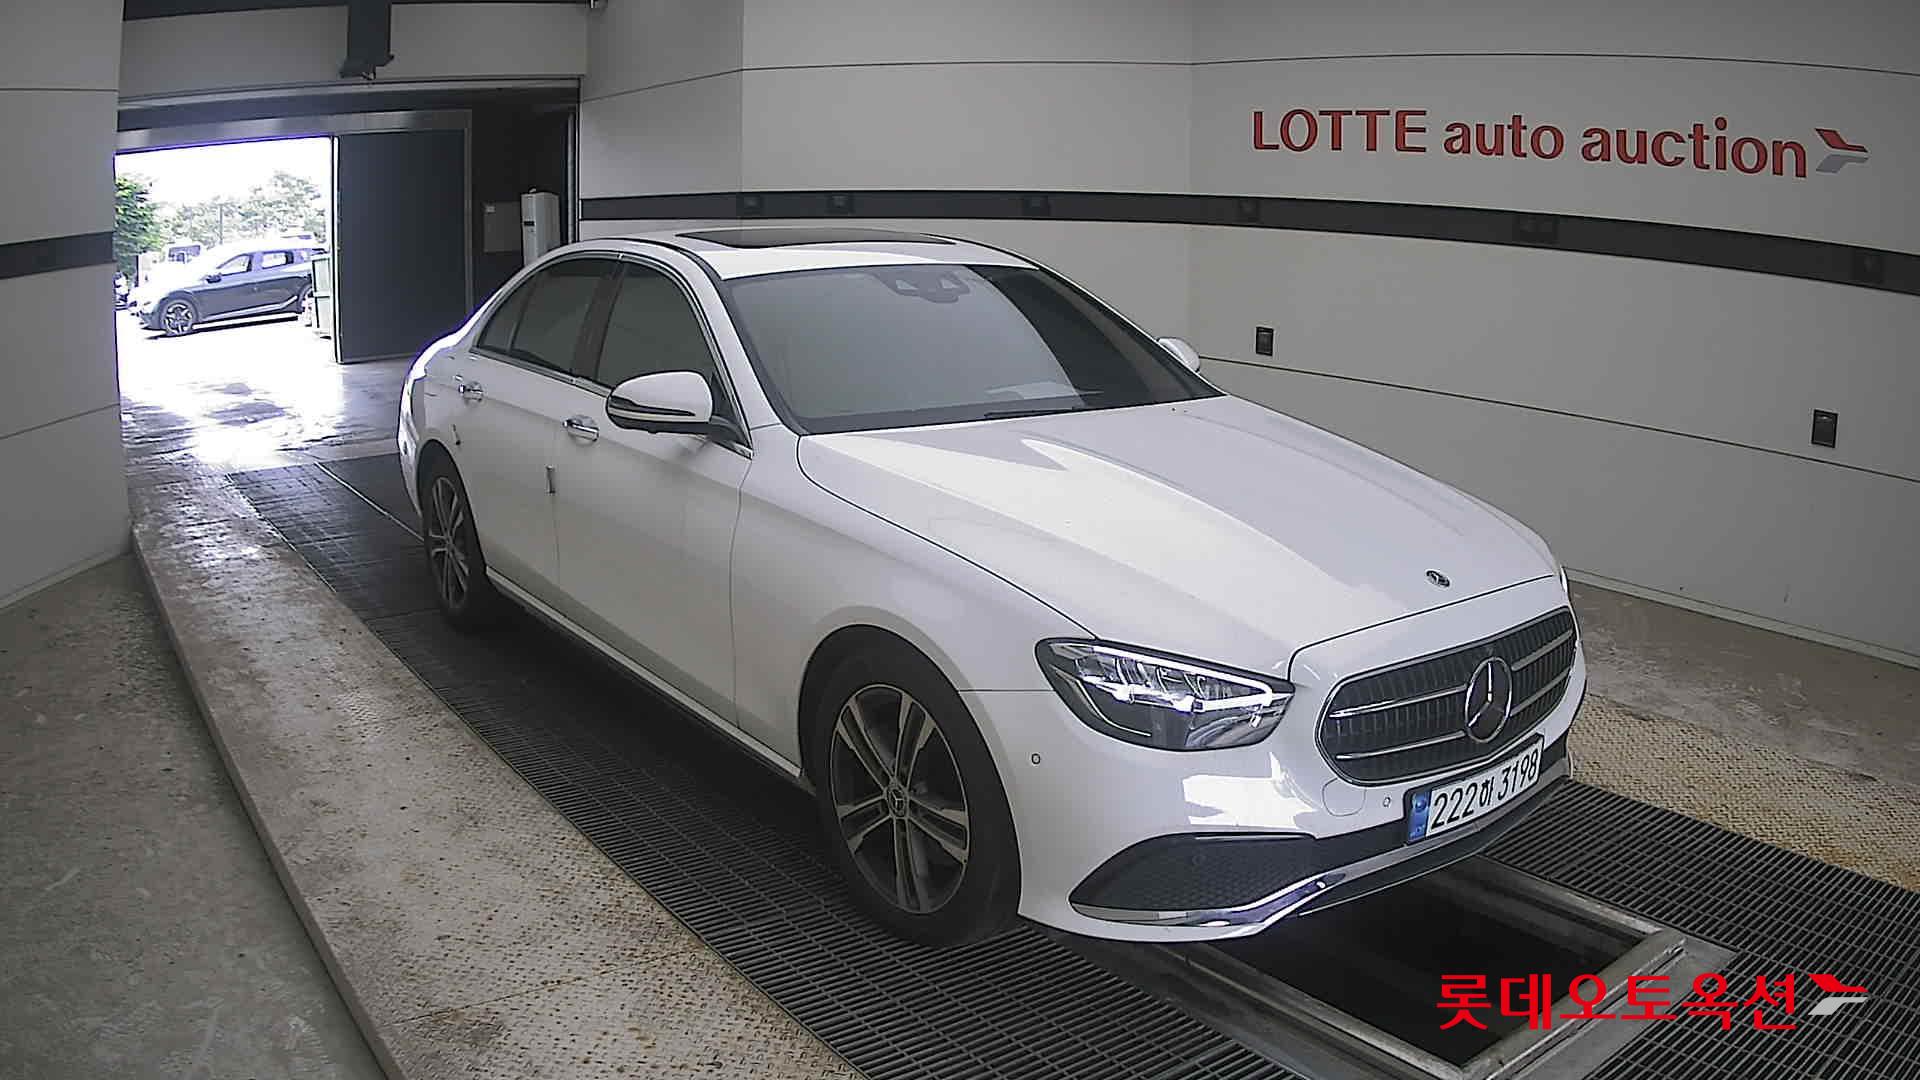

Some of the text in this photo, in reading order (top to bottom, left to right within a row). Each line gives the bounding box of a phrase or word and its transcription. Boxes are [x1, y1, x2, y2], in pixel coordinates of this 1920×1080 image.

[1253, 109, 1807, 178] LOTTE auto auction
[1431, 749, 1538, 830] 222하 3198
